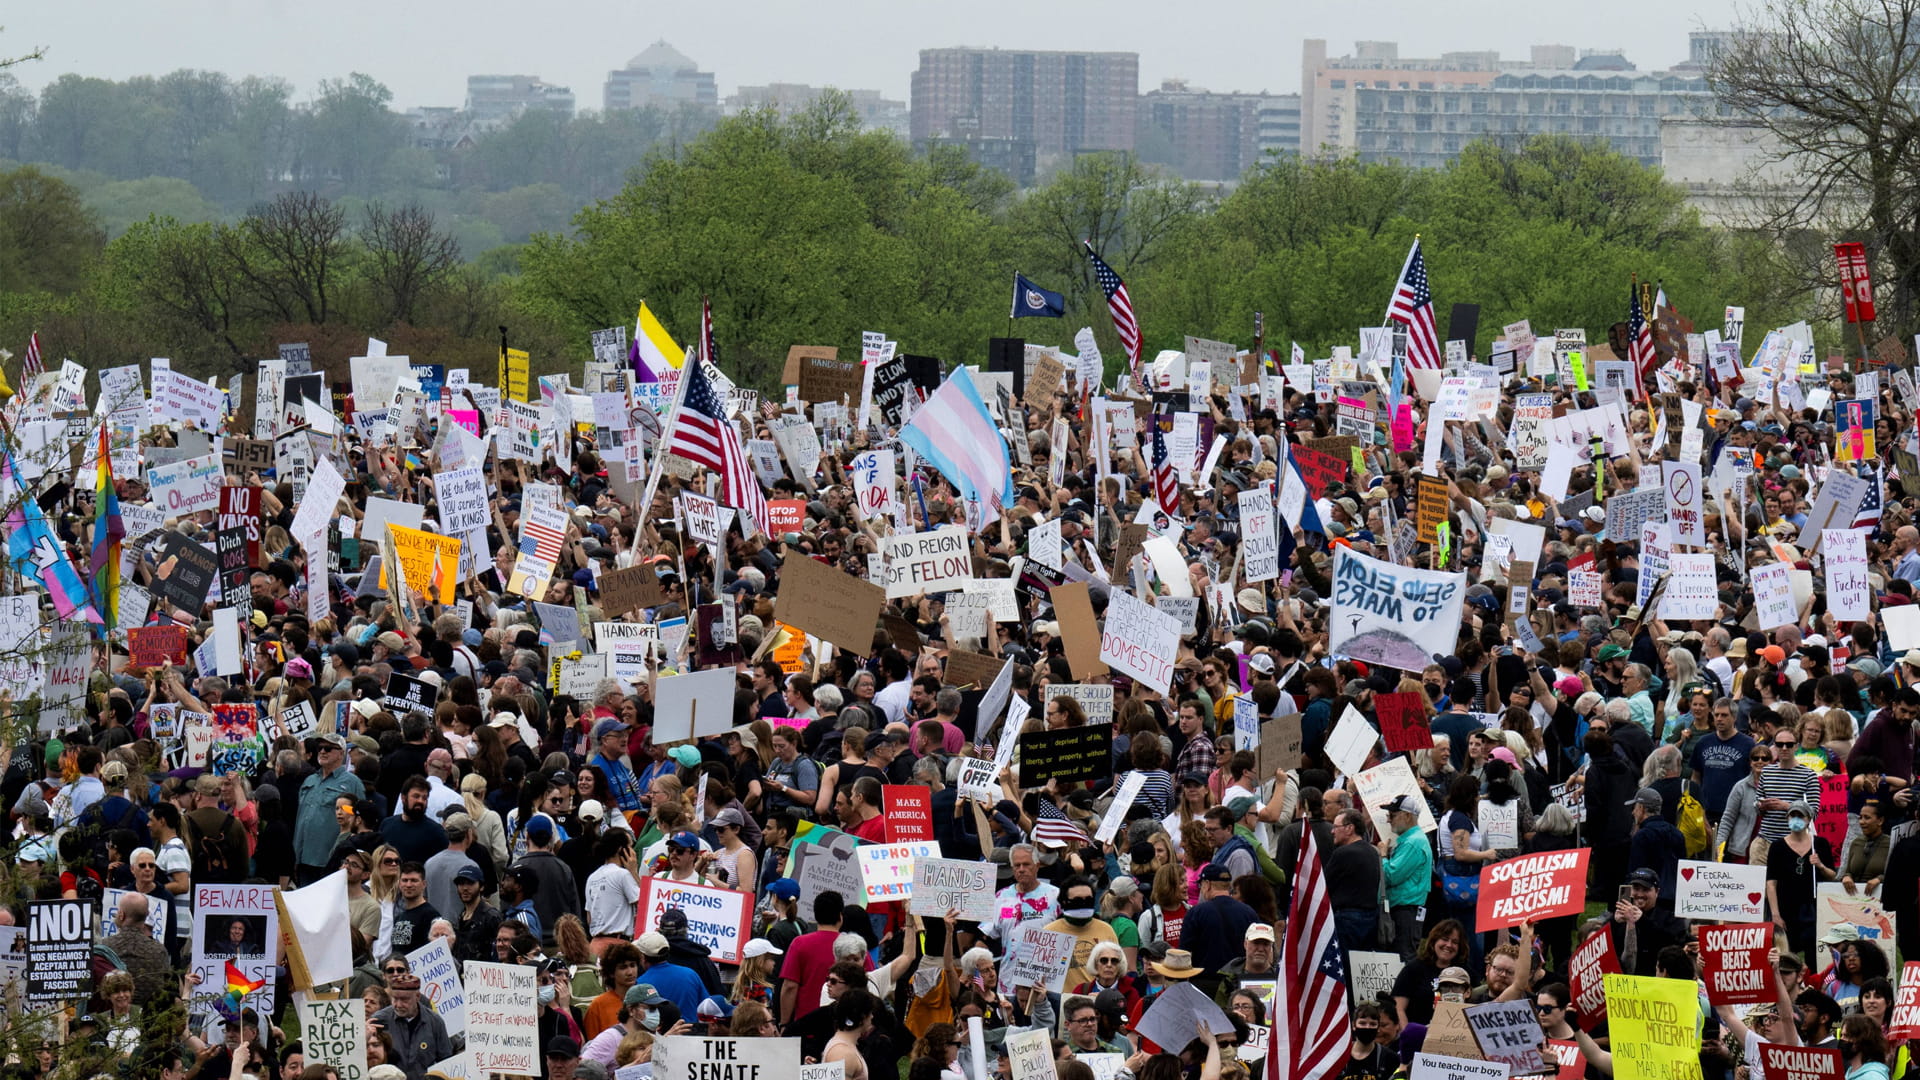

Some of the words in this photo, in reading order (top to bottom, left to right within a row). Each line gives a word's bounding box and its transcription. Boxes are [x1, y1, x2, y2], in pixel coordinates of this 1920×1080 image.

[1559, 330, 1581, 342] Cory
[1517, 419, 1538, 434] GROW
[438, 467, 479, 484] DEMOCRACY
[168, 482, 217, 513] Oligarchs
[441, 485, 452, 498] WE
[453, 483, 465, 495] the
[229, 488, 250, 514] NO
[443, 500, 456, 514] YOU
[685, 495, 715, 518] DEPORT
[1240, 494, 1271, 514] HANDS
[450, 517, 460, 531] NO
[461, 511, 485, 527] KINGS
[769, 506, 797, 517] STOP
[770, 515, 800, 526] RUMP
[1671, 507, 1698, 523] HANDS
[132, 520, 147, 531] NOT
[218, 514, 260, 542] KINGS
[693, 516, 718, 538] HATE
[1249, 514, 1267, 535] OFF
[1678, 522, 1694, 537] OFF
[219, 532, 242, 553] Ditch
[893, 542, 913, 558] ND
[919, 535, 962, 556] REIGN
[1245, 536, 1276, 558] SOCIAL
[179, 546, 215, 575] ORANGE
[222, 549, 248, 569] DOGE
[1247, 556, 1278, 578] SECURITY
[911, 555, 970, 584] FELON
[601, 567, 650, 593] DEMAND
[959, 593, 989, 609] 2025
[1159, 599, 1173, 608] TOO
[1173, 599, 1192, 608] MUCH
[1112, 591, 1155, 619] AGAINST
[1156, 612, 1178, 636] ALL
[1117, 605, 1160, 640] ENEMIES
[602, 624, 638, 639] HANDS
[957, 615, 986, 633] 1984
[131, 634, 187, 651] DEMOCRACY
[614, 642, 642, 652] PROTECT
[1106, 617, 1150, 649] FOREIGN
[1149, 640, 1170, 660] AND
[616, 654, 642, 664] FEDERAL
[1102, 632, 1173, 687] DOMESTIC
[51, 665, 86, 687] MAGA
[572, 669, 587, 678] Law
[405, 691, 423, 702] ARE
[409, 681, 422, 694] WE
[1083, 687, 1112, 699] SHOULD
[384, 695, 435, 716] EVERYWHERE
[1088, 701, 1112, 713] THEIR
[217, 710, 250, 726] NO
[224, 729, 243, 743] to
[967, 758, 997, 773] HANDS
[962, 768, 992, 788] OFF!
[896, 799, 922, 808] MAKE
[888, 811, 927, 820] AMERICA
[1480, 808, 1517, 822] SIGNAL
[894, 825, 924, 834] THINK
[1487, 821, 1512, 835] GATE
[870, 846, 930, 860] UPHOLD
[826, 860, 847, 871] RIP
[1489, 852, 1579, 885] SOCIALISM
[807, 864, 859, 887] AMERICA
[923, 863, 986, 891] HANDS
[1511, 872, 1553, 897] BEATS
[1690, 889, 1711, 899] KEEP
[1713, 889, 1726, 899] US
[1708, 881, 1746, 891] WORKERS
[199, 888, 275, 910] BEWARE
[657, 888, 723, 910] MORONS
[936, 891, 970, 913] OFF
[1492, 885, 1571, 919] FASCISM!
[29, 903, 92, 942] ¡NO!
[1023, 928, 1058, 947] KNOWLEDGE
[1063, 935, 1072, 951] IS
[1705, 927, 1766, 951] SOCIALISM
[31, 952, 46, 962] NOS
[47, 951, 83, 961] NEGAMOS
[84, 951, 91, 960] A
[420, 946, 445, 968] YOUR
[1032, 948, 1058, 967] POWER
[1570, 931, 1609, 978] SOCIALISM
[1722, 951, 1751, 969] BEATS
[30, 971, 63, 981] ESTADOS
[64, 969, 91, 980] UNIDOS
[34, 961, 68, 971] ACEPTAR
[69, 961, 75, 970] A
[76, 960, 87, 969] UN
[423, 961, 452, 984] HANDS
[43, 980, 78, 990] FASCISTA
[443, 976, 456, 993] MY
[480, 967, 509, 989] MORAL
[509, 971, 534, 990] MOMENT
[1355, 977, 1396, 992] PRESIDENT
[1580, 960, 1603, 992] BEATS
[1714, 969, 1764, 993] FASCISM!
[308, 1002, 353, 1019] TAX
[321, 1014, 338, 1025] THE
[1609, 997, 1678, 1023] RADICALIZED
[1470, 1012, 1504, 1031] TAKE
[1506, 1009, 1536, 1024] BACK
[308, 1023, 359, 1042] RICH:
[1439, 1034, 1467, 1044] people
[1487, 1028, 1532, 1049] THE
[1645, 1021, 1695, 1050] MODERATE
[308, 1041, 356, 1059] STOP
[703, 1040, 738, 1060] THE
[1011, 1040, 1043, 1057] Remember
[323, 1057, 342, 1066] THE
[475, 1051, 485, 1068] BE
[489, 1052, 531, 1069] COURAGEOUS!
[1422, 1057, 1437, 1068] You
[1438, 1060, 1463, 1071] teach
[1464, 1064, 1480, 1074] our
[1480, 1064, 1503, 1078] boys
[1768, 1049, 1835, 1075] SOCIALISM
[688, 1061, 760, 1080] SENATE
